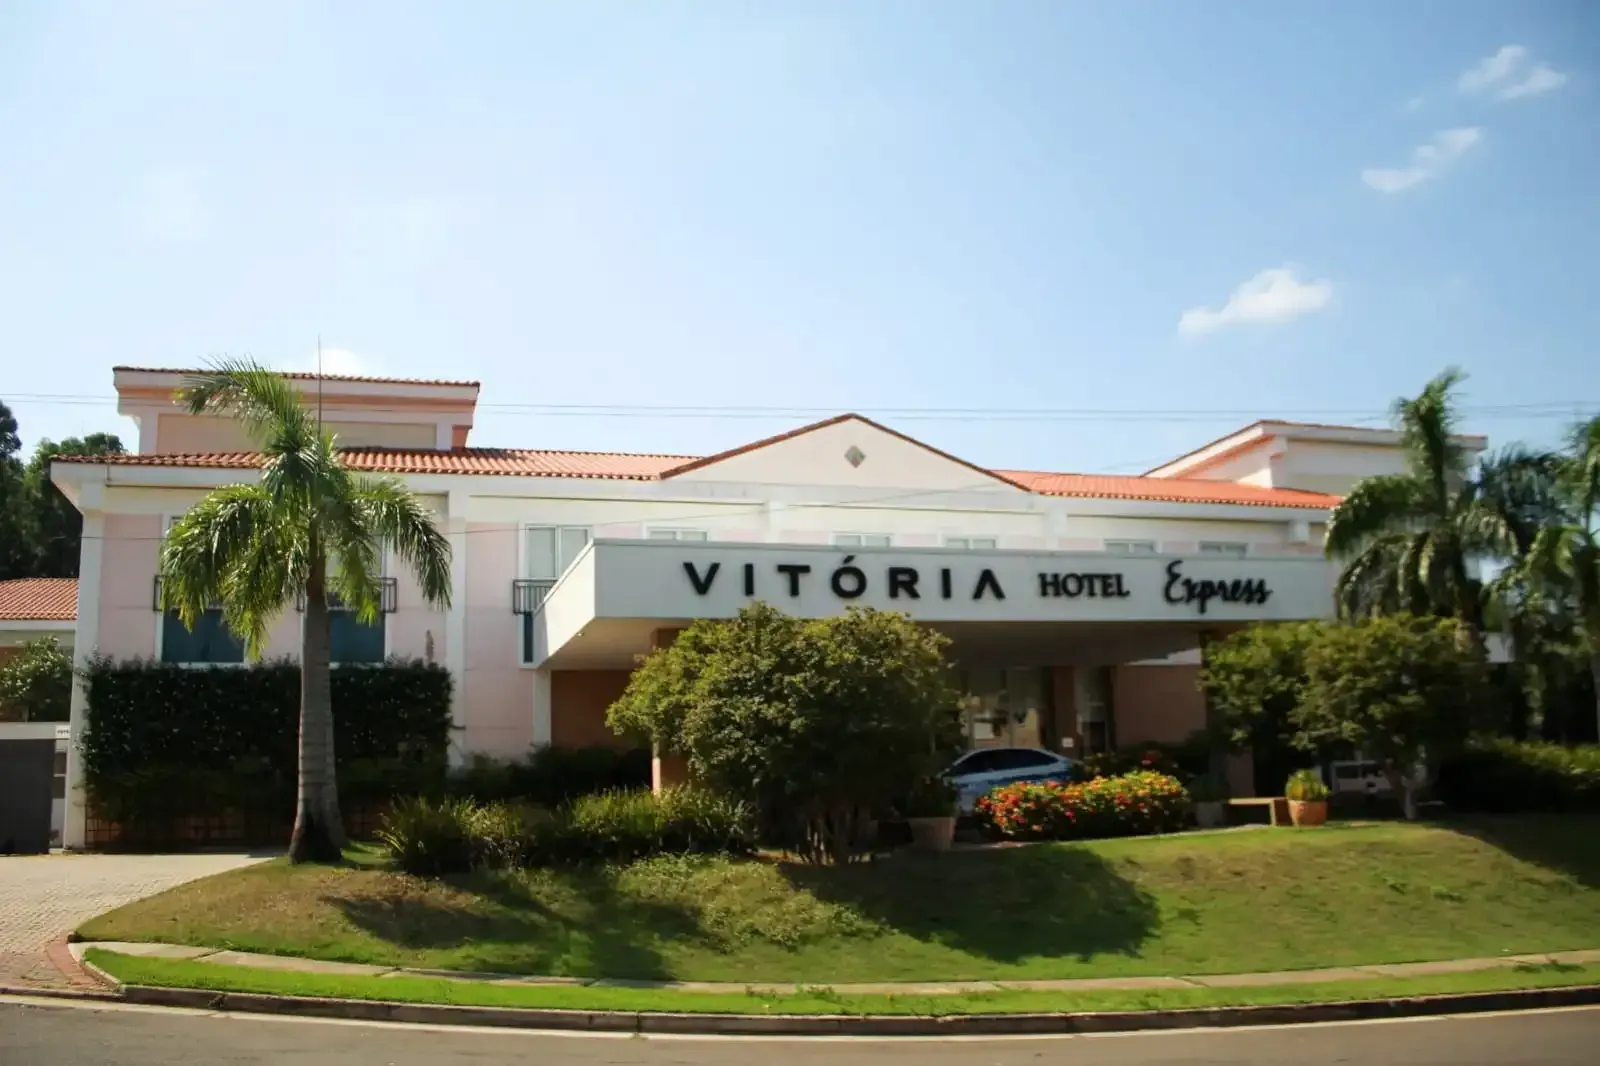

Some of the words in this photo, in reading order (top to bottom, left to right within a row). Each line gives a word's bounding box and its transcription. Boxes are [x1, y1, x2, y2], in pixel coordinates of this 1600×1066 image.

[682, 554, 1006, 602] VITÓRIA
[1038, 572, 1131, 599] HOTEL
[1162, 558, 1275, 616] Express
